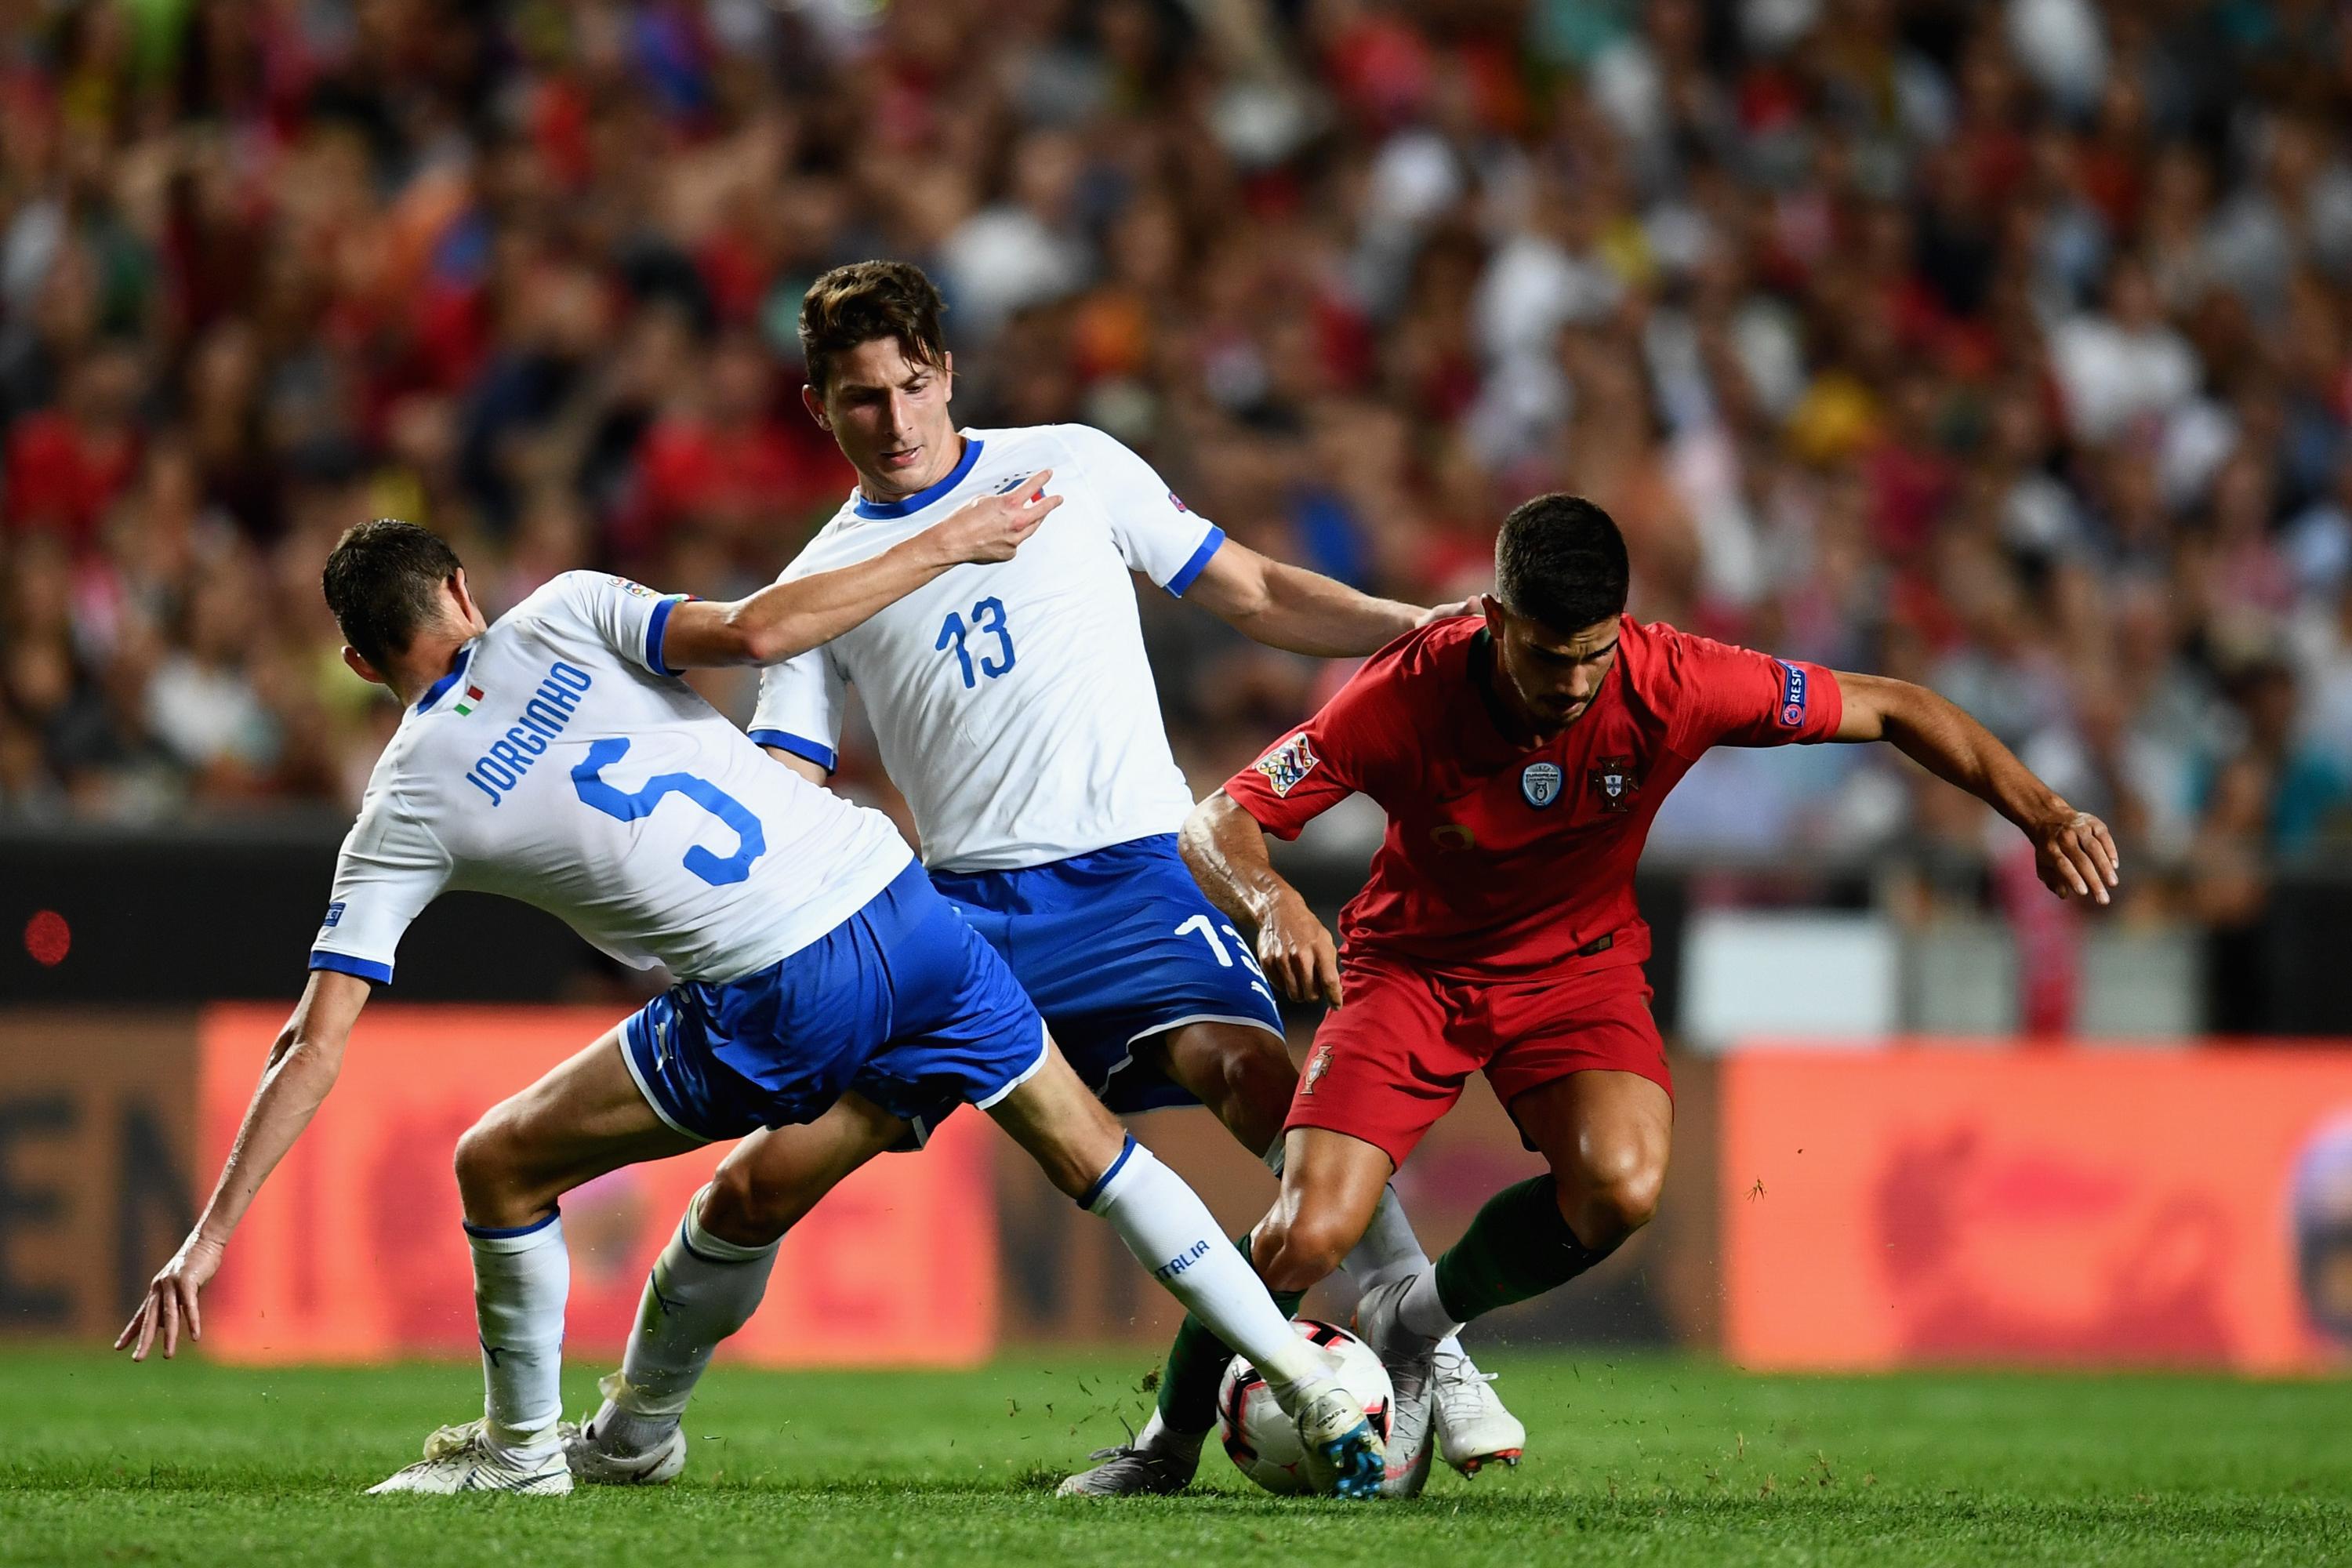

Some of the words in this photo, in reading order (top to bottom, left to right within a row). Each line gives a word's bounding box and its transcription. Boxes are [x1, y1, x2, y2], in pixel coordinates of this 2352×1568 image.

[935, 596, 1016, 689] 13
[465, 661, 593, 808] JORGINHO
[570, 737, 767, 887] 5
[1155, 1240, 1210, 1281] ITALIA
